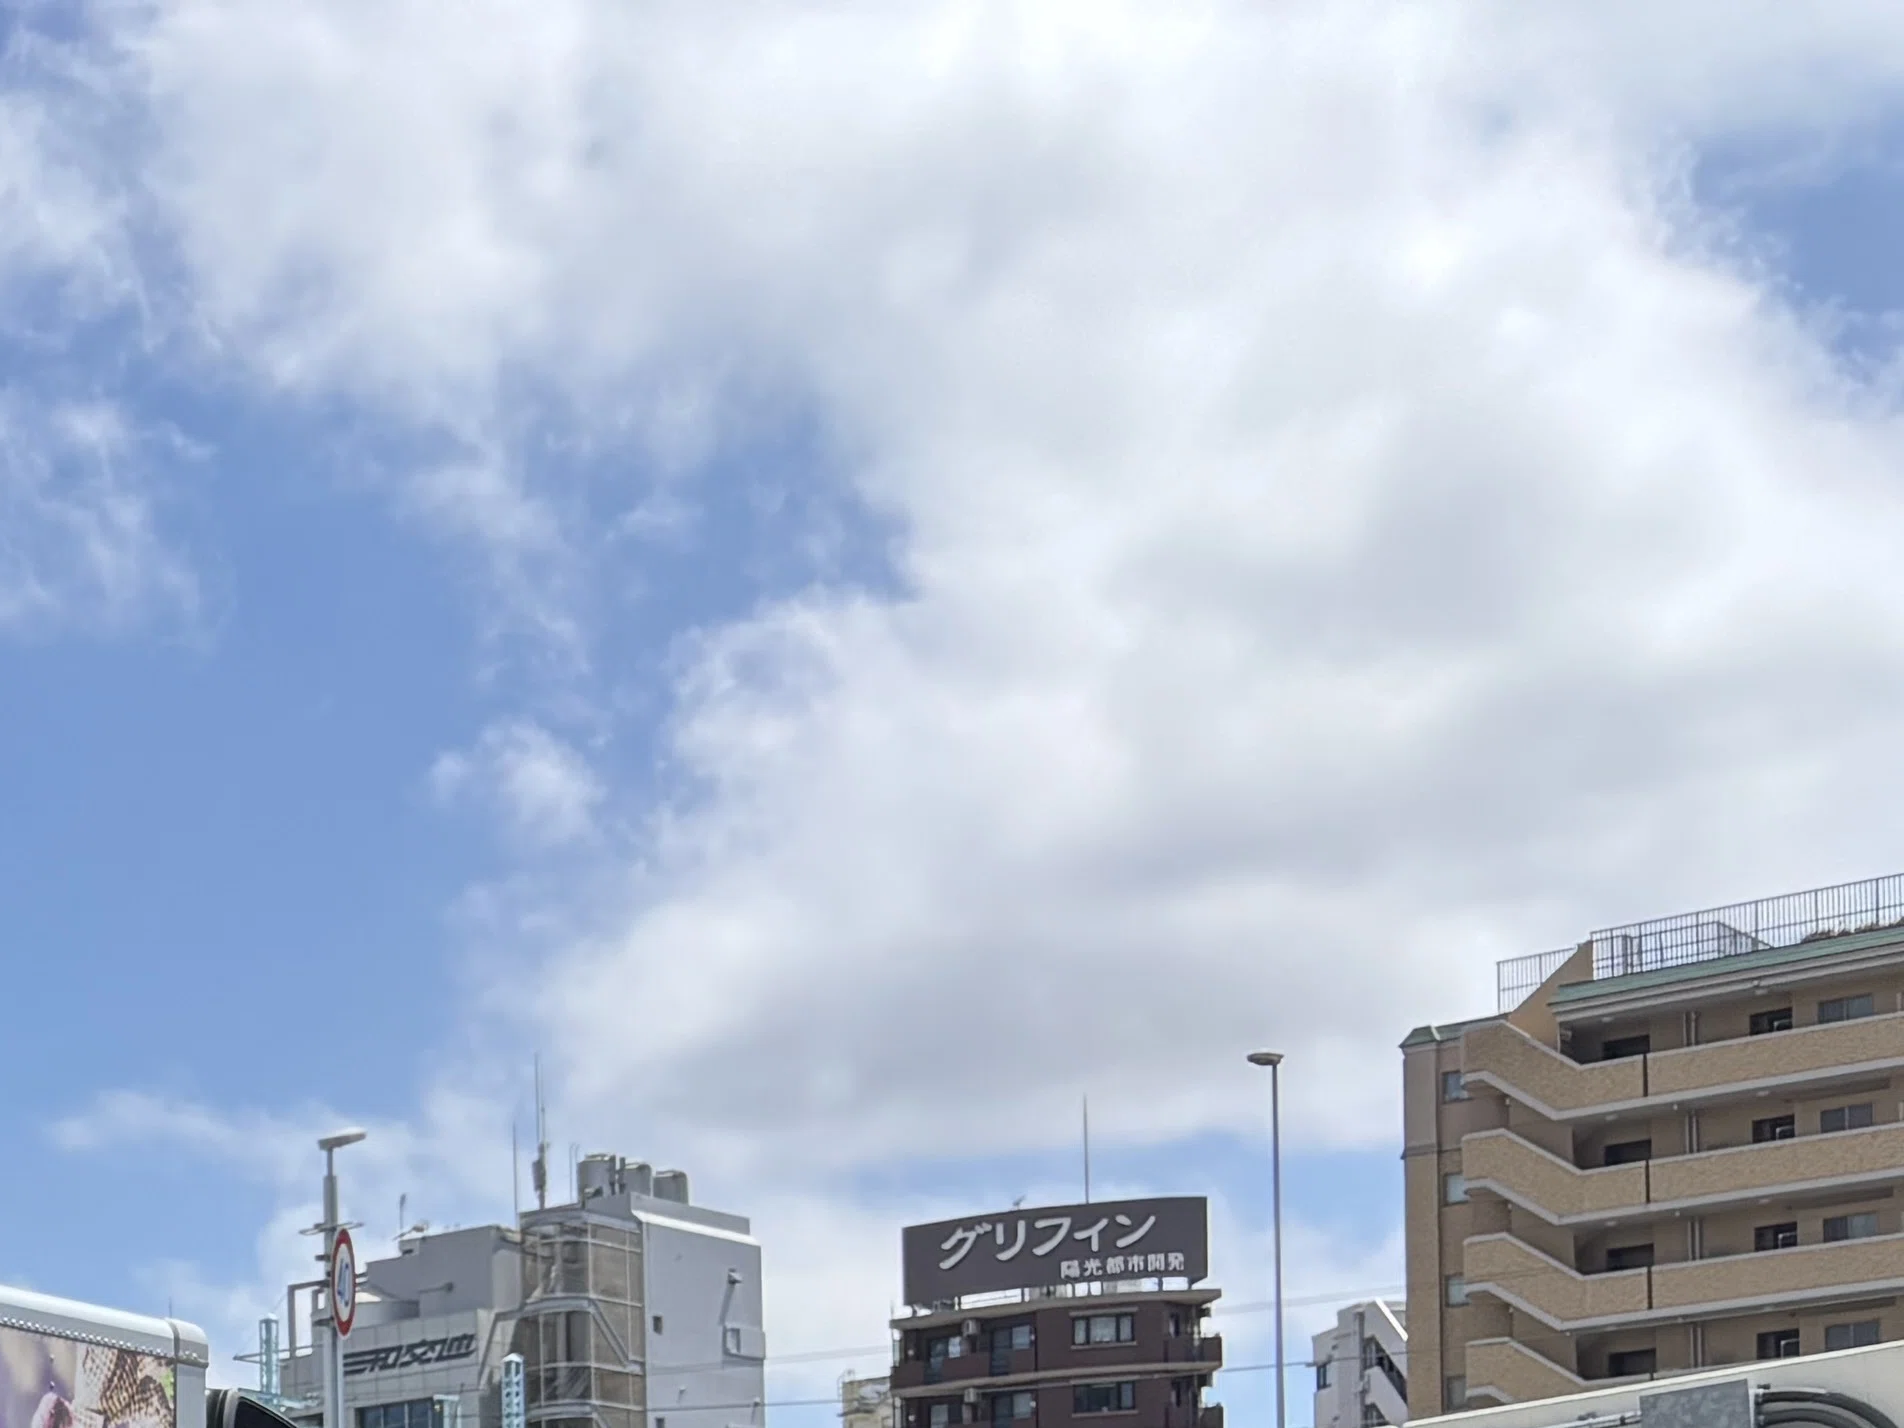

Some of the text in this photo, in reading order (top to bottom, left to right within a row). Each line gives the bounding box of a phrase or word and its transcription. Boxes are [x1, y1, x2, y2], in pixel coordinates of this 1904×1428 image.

[939, 1214, 1155, 1269] グリフィン
